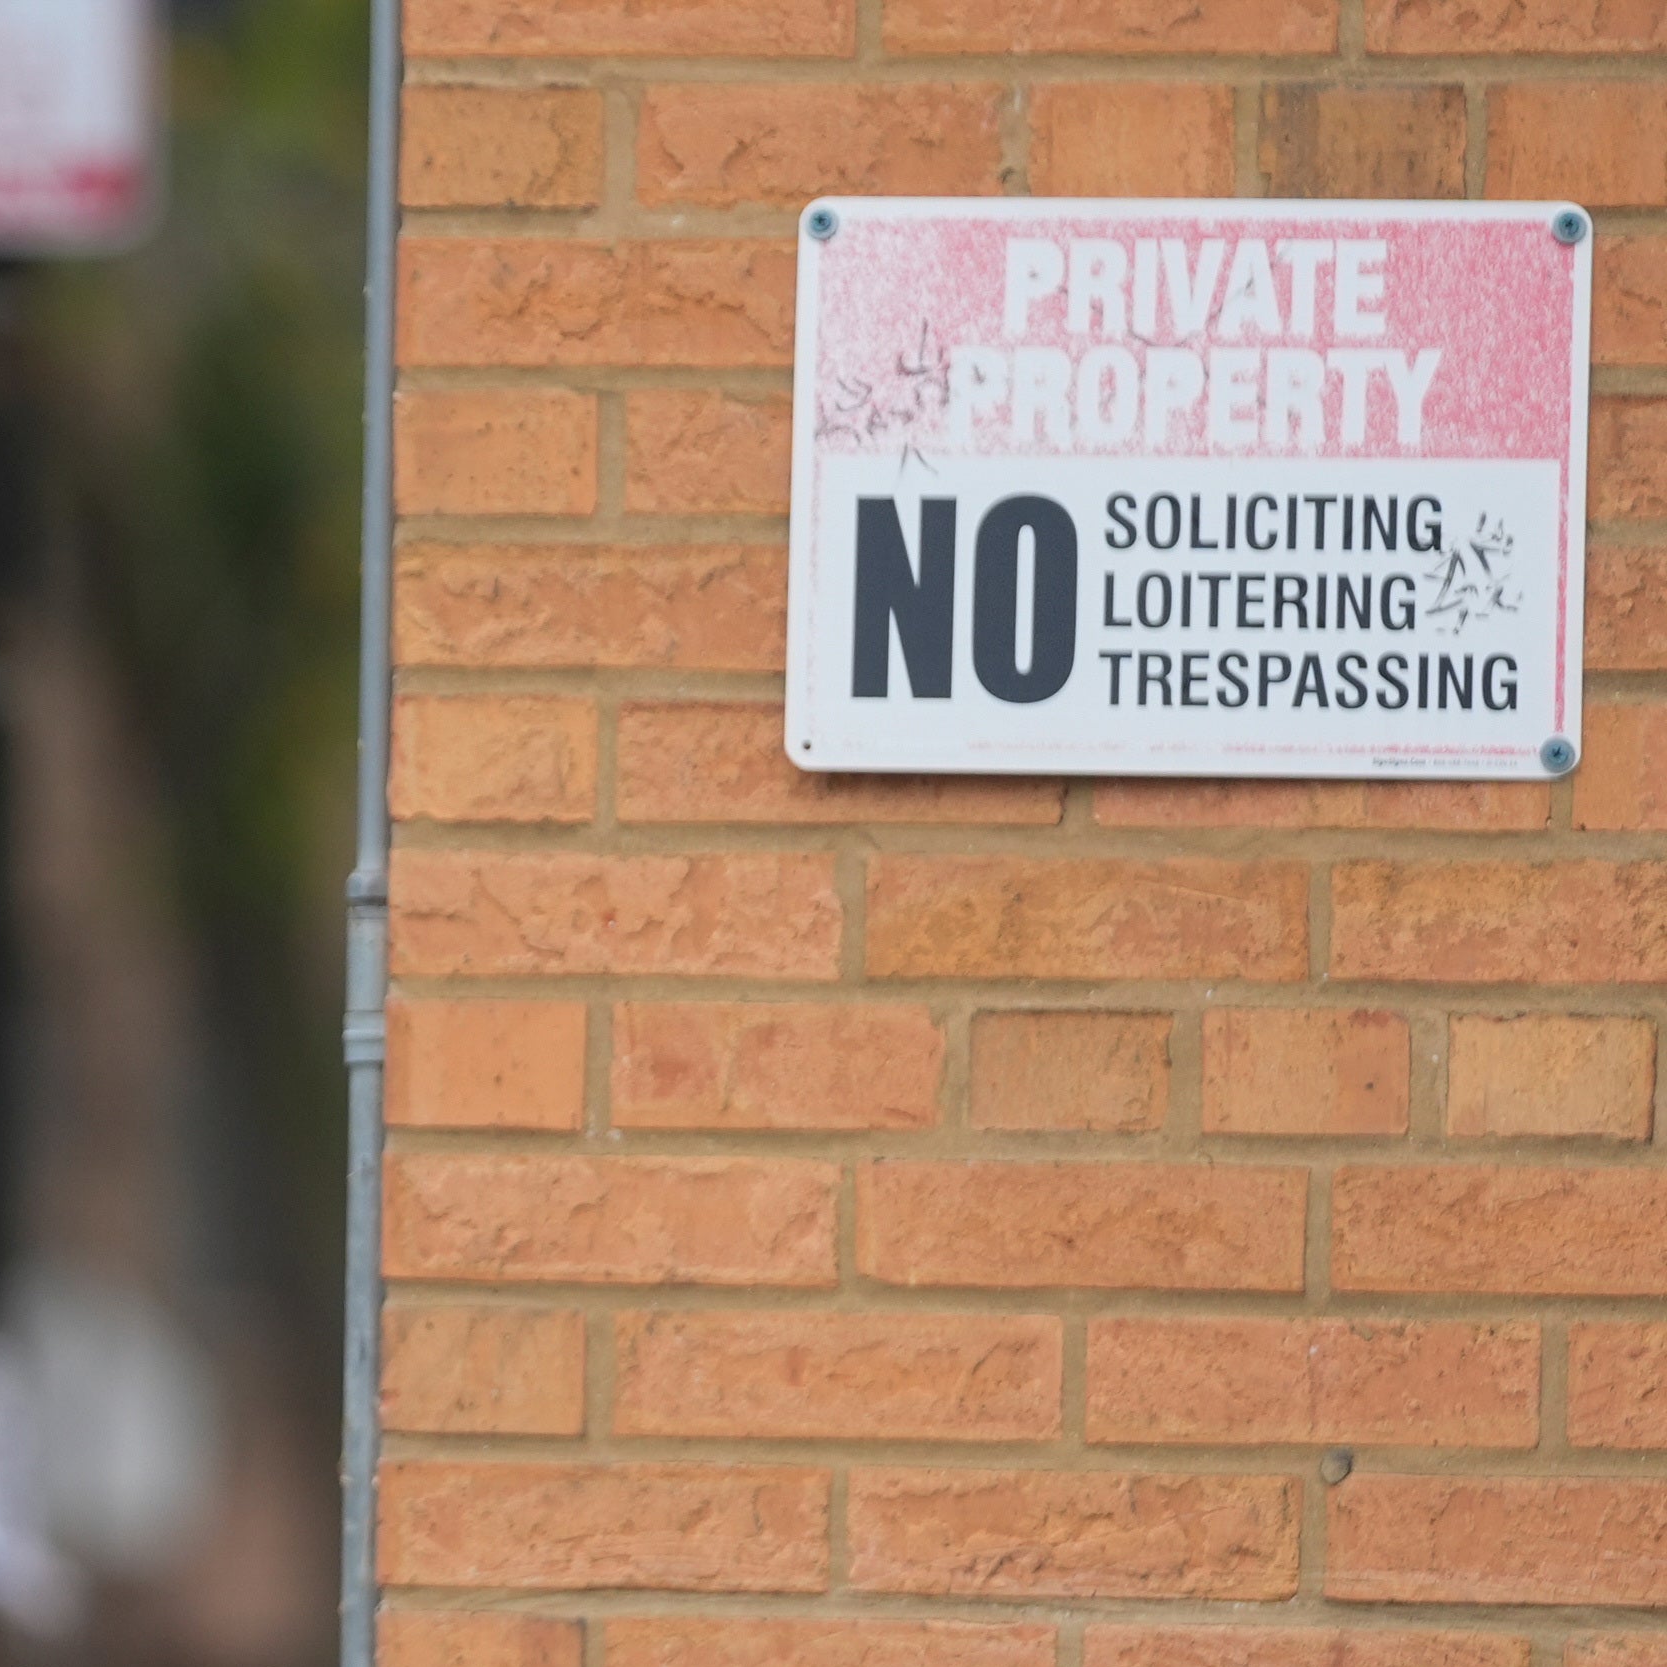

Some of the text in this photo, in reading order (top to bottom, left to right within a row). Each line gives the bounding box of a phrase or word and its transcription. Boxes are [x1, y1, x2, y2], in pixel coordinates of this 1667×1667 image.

[1003, 239, 1388, 337] PRIVATE
[947, 344, 1443, 448] PROPERTY
[1104, 491, 1444, 552] SOLICITING
[851, 491, 1078, 704] NO
[1103, 570, 1417, 631] LOITERING
[1099, 650, 1519, 712] TRESPASSING
